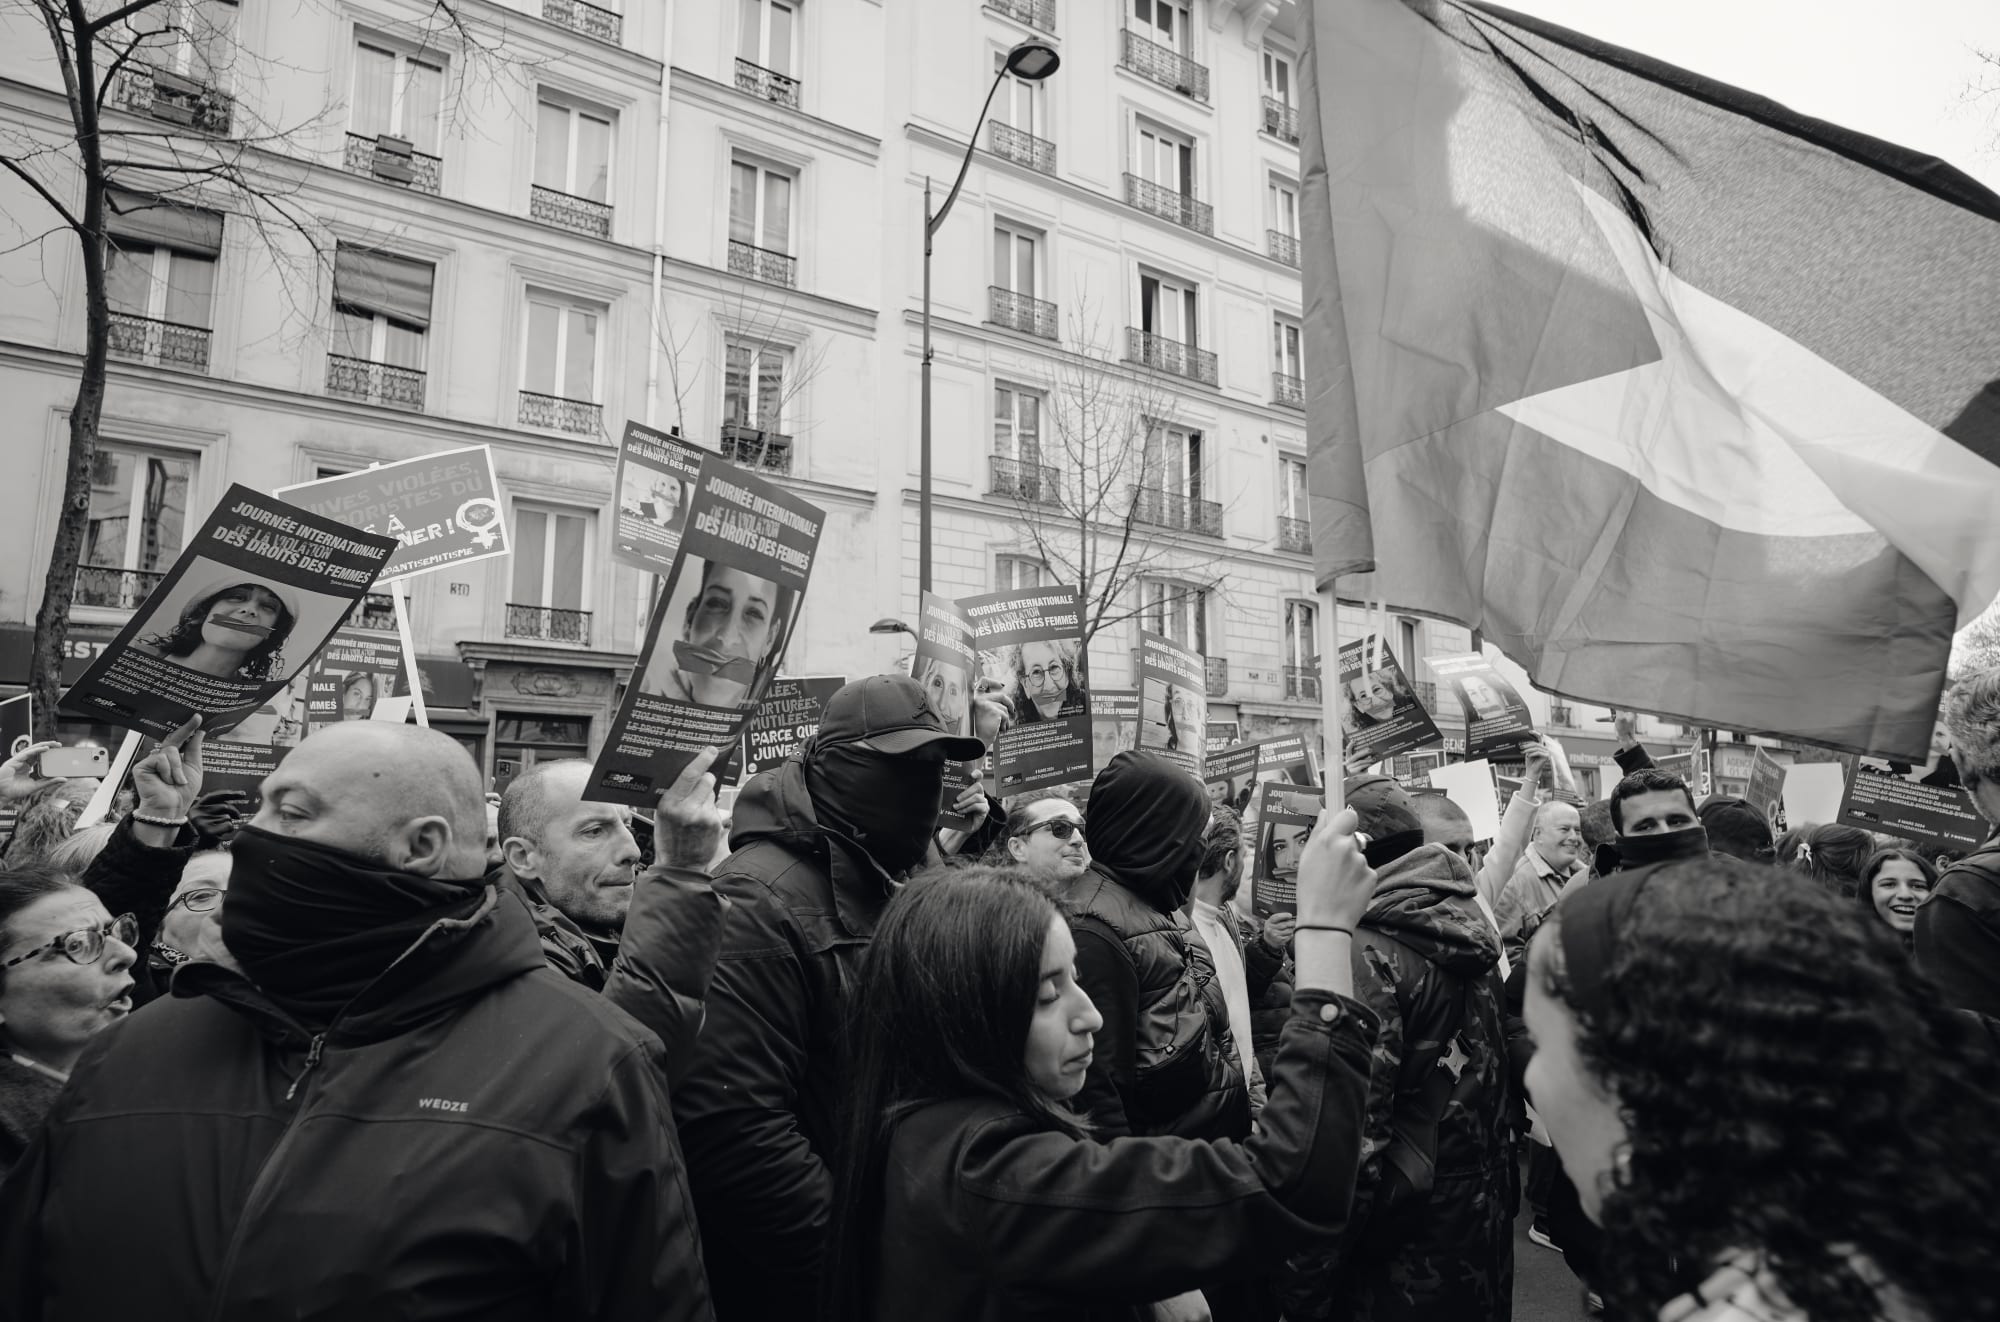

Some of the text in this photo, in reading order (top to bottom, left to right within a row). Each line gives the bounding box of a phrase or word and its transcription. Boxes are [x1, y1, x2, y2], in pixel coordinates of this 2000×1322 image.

[630, 429, 663, 447] JOURNÉE
[627, 443, 643, 456] DES
[642, 448, 669, 466] DROITS
[669, 459, 684, 471] DES
[377, 461, 480, 498] VIOLÉES,
[450, 476, 484, 497] DU
[705, 476, 818, 538] JOURNÉE INTERNATIONALE
[231, 501, 386, 560] JOURNÉE INTERNATIONALE
[387, 514, 406, 535] À
[394, 521, 444, 552] NER
[695, 511, 720, 536] DES
[719, 520, 759, 551] DROITS
[756, 535, 778, 558] DES
[212, 525, 247, 547] DES
[246, 538, 299, 566] DROITS
[298, 555, 326, 575] DES
[272, 532, 333, 560] VIOLATION
[1007, 594, 1074, 611] INTERNATIONALE
[993, 618, 1027, 634] DROITS
[1027, 616, 1045, 628] DES
[329, 638, 401, 653] JOURNÉE INTERNATIONALE
[136, 655, 167, 669] DROIT
[327, 651, 340, 660] DES
[363, 656, 376, 664] DES
[312, 683, 336, 692] NALE
[764, 682, 801, 699] LÉES,
[751, 728, 794, 747] PARCE
[796, 724, 820, 739] QUE
[602, 779, 649, 792] ensemble
[612, 773, 634, 783] agir
[1266, 804, 1283, 814] DES
[419, 1097, 469, 1113] WEDZE
